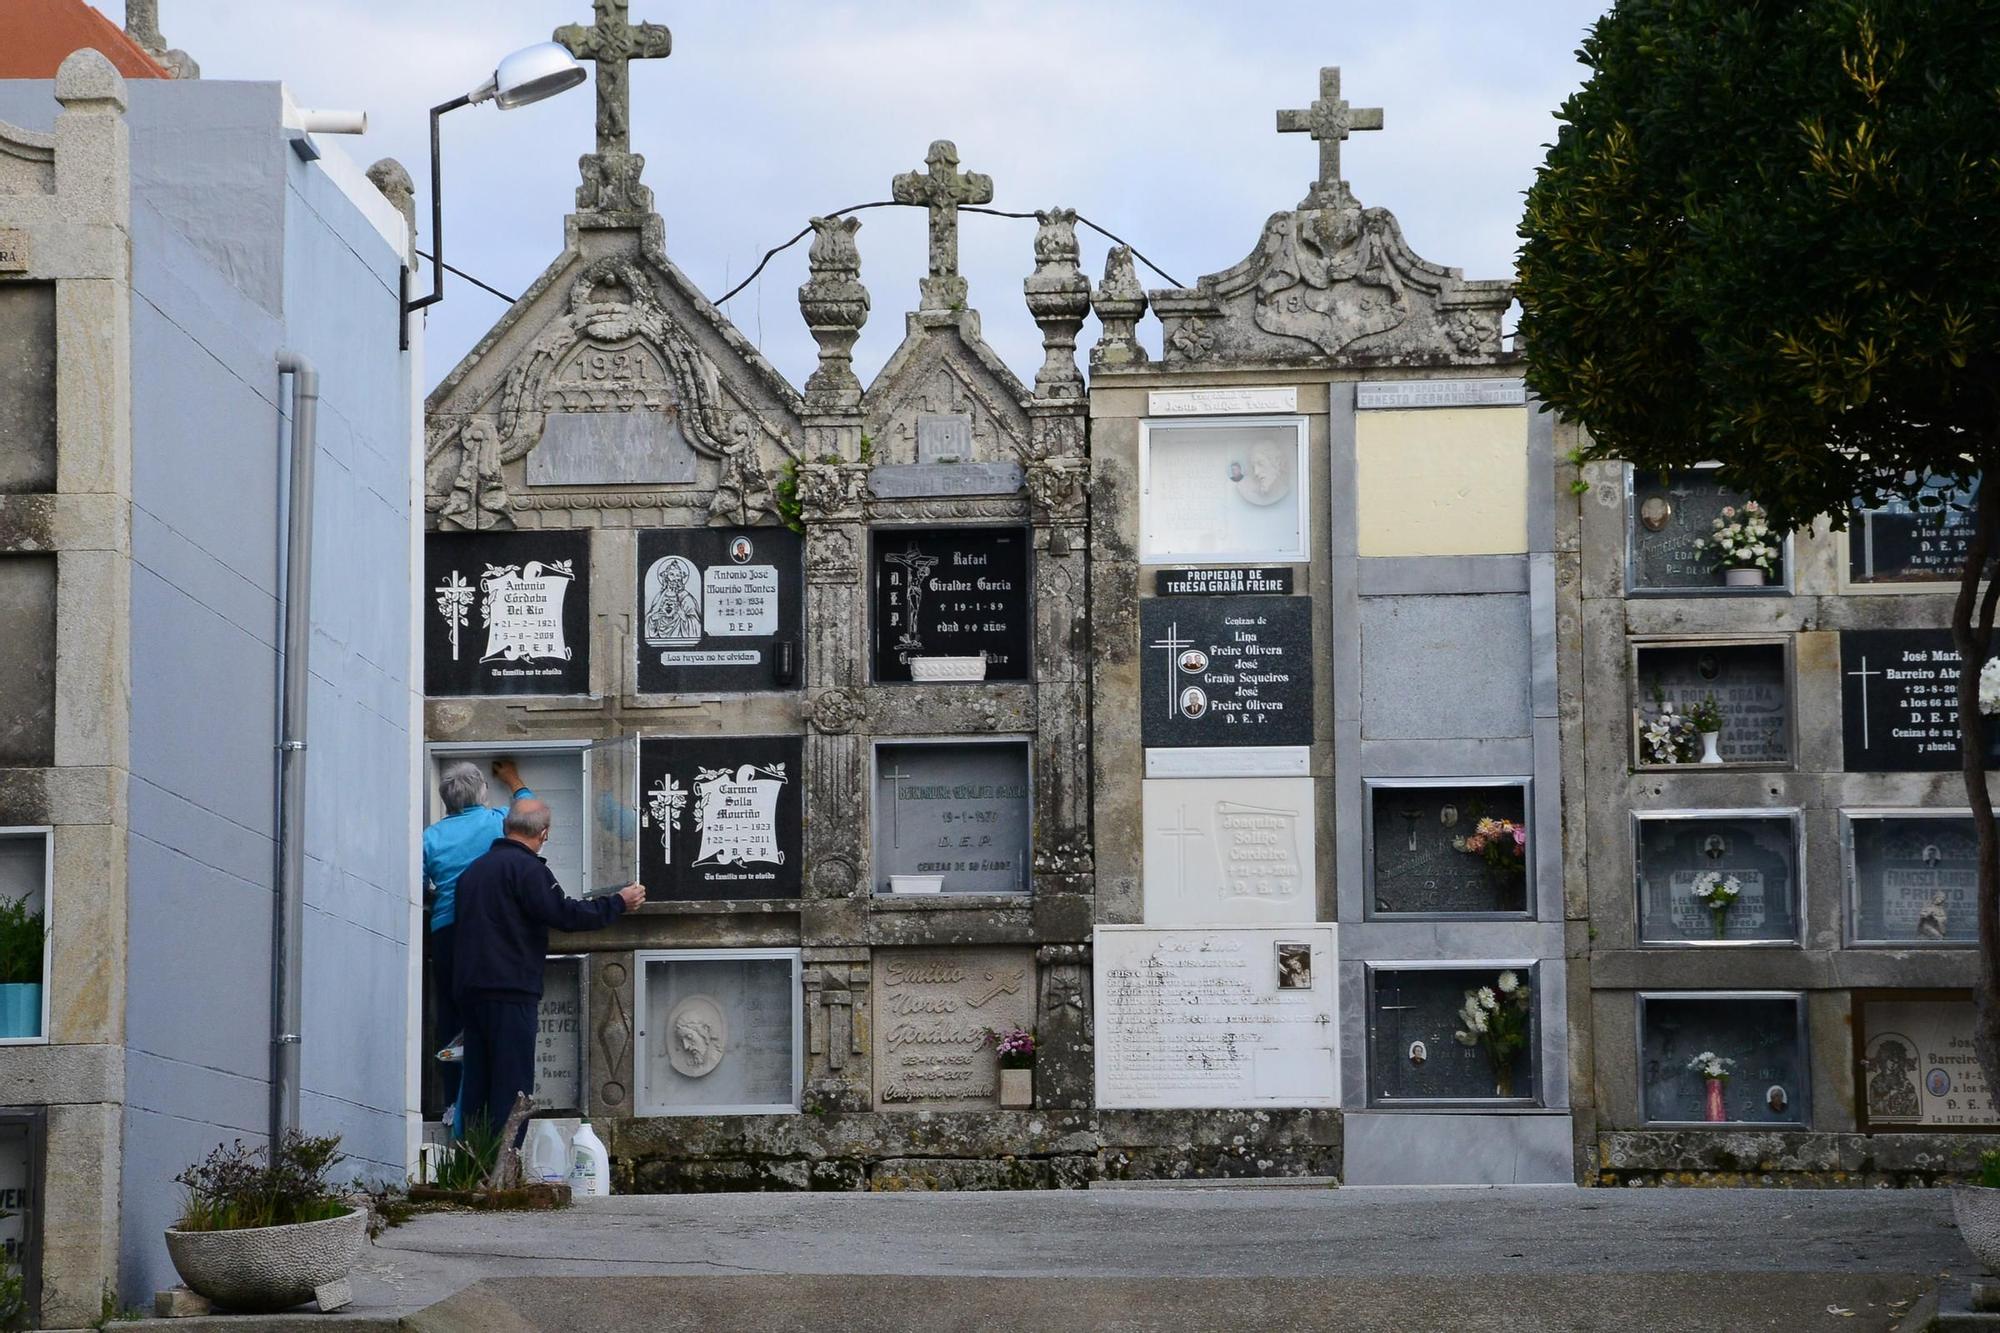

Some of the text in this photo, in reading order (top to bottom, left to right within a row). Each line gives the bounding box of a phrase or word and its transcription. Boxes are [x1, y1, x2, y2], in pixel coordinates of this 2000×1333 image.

[576, 354, 649, 380] 1921
[1896, 503, 1942, 514] Baeiro
[1921, 540, 1967, 552] D. E. P.
[953, 552, 988, 565] Rafael
[1675, 552, 1693, 561] EDA
[714, 570, 748, 580] Antonio
[1188, 570, 1262, 581] PROPIEDAD DE
[506, 580, 546, 590] Antonio
[706, 584, 776, 594] Mouriño Montes
[930, 578, 972, 592] Giraldez
[1168, 579, 1283, 593] TERESA GRAÑA FREIRE
[507, 605, 523, 615] Del
[1225, 616, 1267, 626] Cenizas de
[937, 622, 959, 632] edad
[1235, 632, 1257, 642] Lina
[1210, 644, 1282, 656] Freire Olivera
[667, 654, 680, 662] Los
[682, 655, 704, 663] tuyos
[726, 653, 754, 661] olvidan
[1902, 650, 1962, 662] José Mari
[1235, 658, 1258, 670] José
[1204, 672, 1289, 685] Graña Sequeiros
[1886, 668, 1960, 680] Barreiro Abe
[1235, 686, 1258, 697] José
[1212, 700, 1283, 711] Freire Olivera
[1910, 698, 1927, 708] los
[1944, 698, 1958, 706] añ
[1226, 714, 1268, 724] D. E. P.
[1911, 712, 1958, 723] D. E. P
[1892, 728, 1926, 738] Cenizas
[1929, 728, 1940, 738] de
[1918, 742, 1956, 753] y abuela
[719, 784, 758, 794] Carmen
[725, 796, 752, 806] Solla
[716, 808, 760, 819] Mouriño
[540, 1020, 578, 1033] TEVEZ
[1948, 1036, 1973, 1048] Jos
[1928, 1053, 1979, 1064] Barreiro
